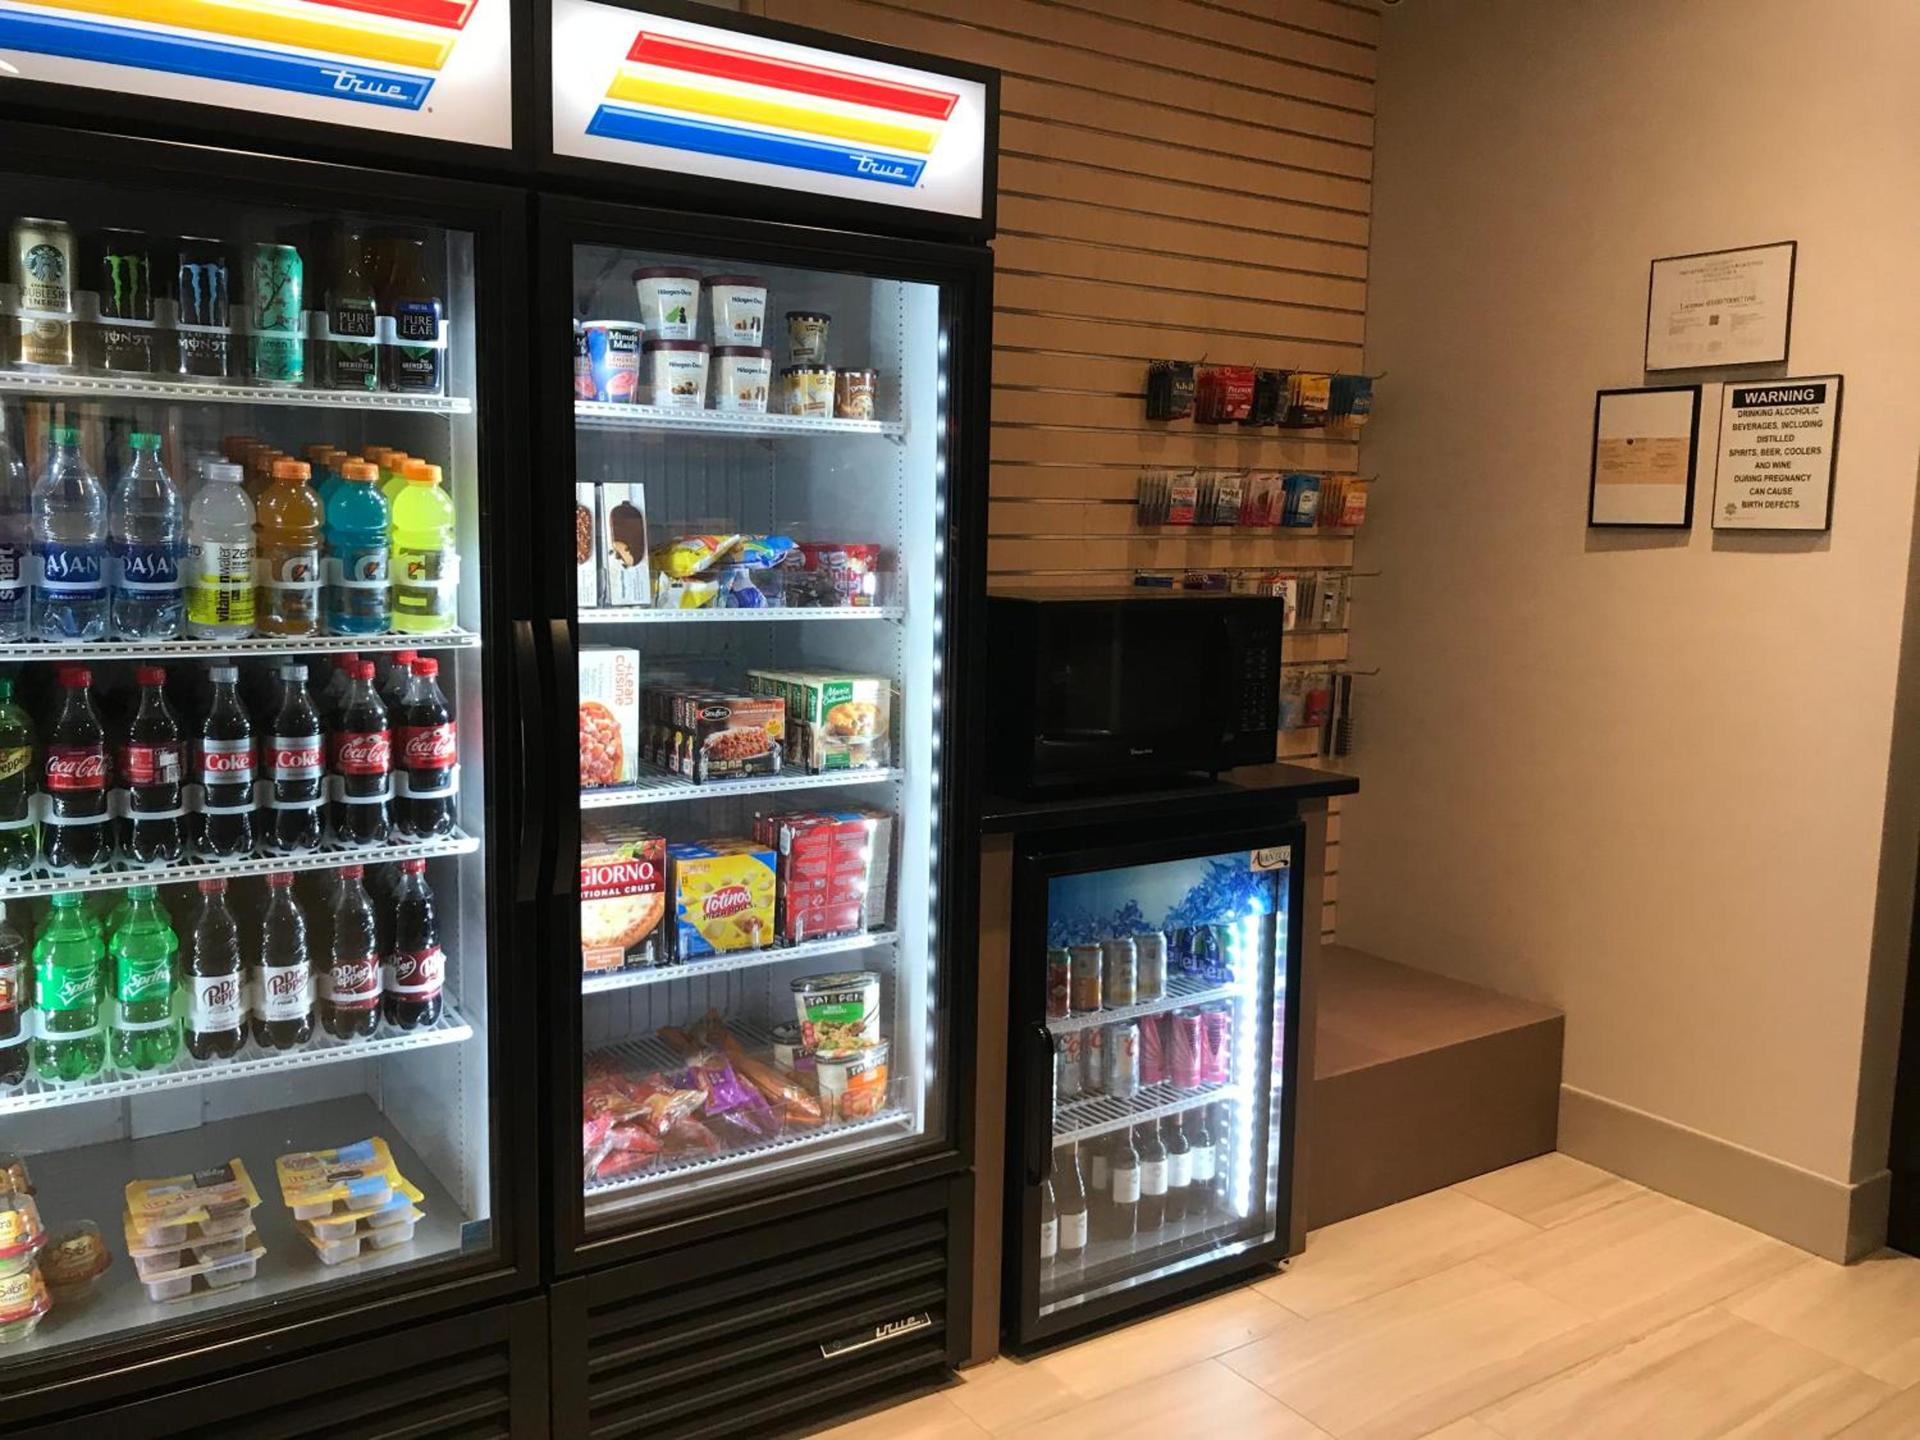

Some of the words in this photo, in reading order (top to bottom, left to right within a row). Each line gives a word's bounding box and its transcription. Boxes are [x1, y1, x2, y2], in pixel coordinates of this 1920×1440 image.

[320, 70, 408, 99] true
[849, 155, 908, 178] true
[403, 314, 433, 325] PURE
[1744, 388, 1815, 404] WARNING
[1737, 408, 1773, 418] DRINKING
[1775, 406, 1819, 416] ALCOHOLIC
[1732, 421, 1778, 431] BEVERAGES,
[1781, 419, 1823, 429] INCLUDING
[1756, 434, 1795, 443] DISTILLED
[1728, 448, 1757, 457] SPIRITS,
[1759, 448, 1782, 457] BEER,
[1784, 447, 1822, 456] COOLERS
[1754, 461, 1771, 469] AND
[1771, 461, 1792, 469] WINE
[1733, 474, 1762, 483] DURING
[1763, 474, 1812, 482] PREGNANCY
[1749, 488, 1765, 496] CAN
[1766, 487, 1793, 495] CAUSE
[1741, 500, 1763, 509] BIRTH
[1764, 500, 1800, 509] DEFECTS
[47, 551, 98, 577] ASAN
[120, 553, 178, 578] DASAN
[205, 754, 249, 770] Coke
[277, 750, 320, 768] Coke
[581, 862, 655, 888] GIORNO
[624, 882, 657, 894] CRUST
[701, 886, 752, 913] Totino's
[61, 975, 98, 996] Sprit
[203, 985, 238, 1007] Pepp
[876, 1315, 920, 1338] true
